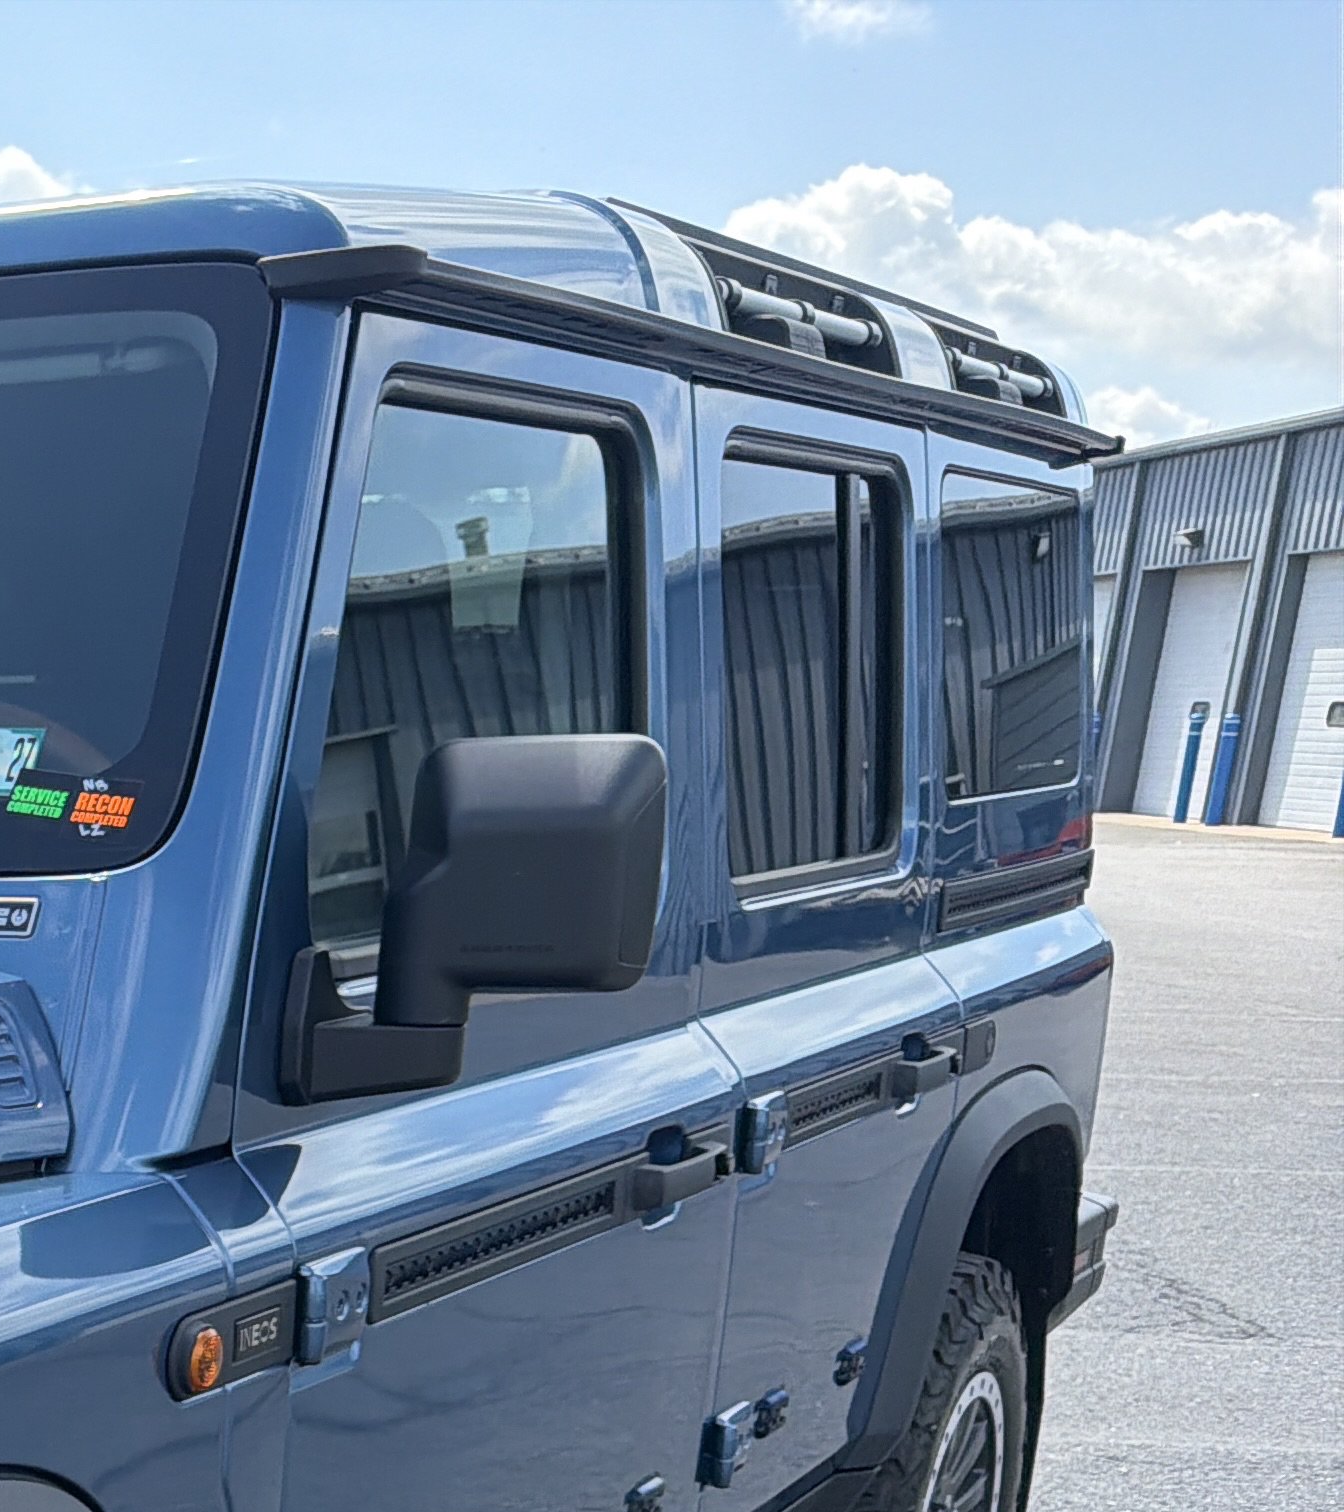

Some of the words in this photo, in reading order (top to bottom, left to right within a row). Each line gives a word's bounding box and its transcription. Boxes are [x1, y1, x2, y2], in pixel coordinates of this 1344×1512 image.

[5, 737, 37, 783] 27
[12, 784, 70, 807] SERVICE
[75, 791, 135, 816] RECON
[6, 801, 63, 819] COMPLETED
[70, 811, 129, 828] COMPLETED
[239, 1316, 278, 1351] INEOS
